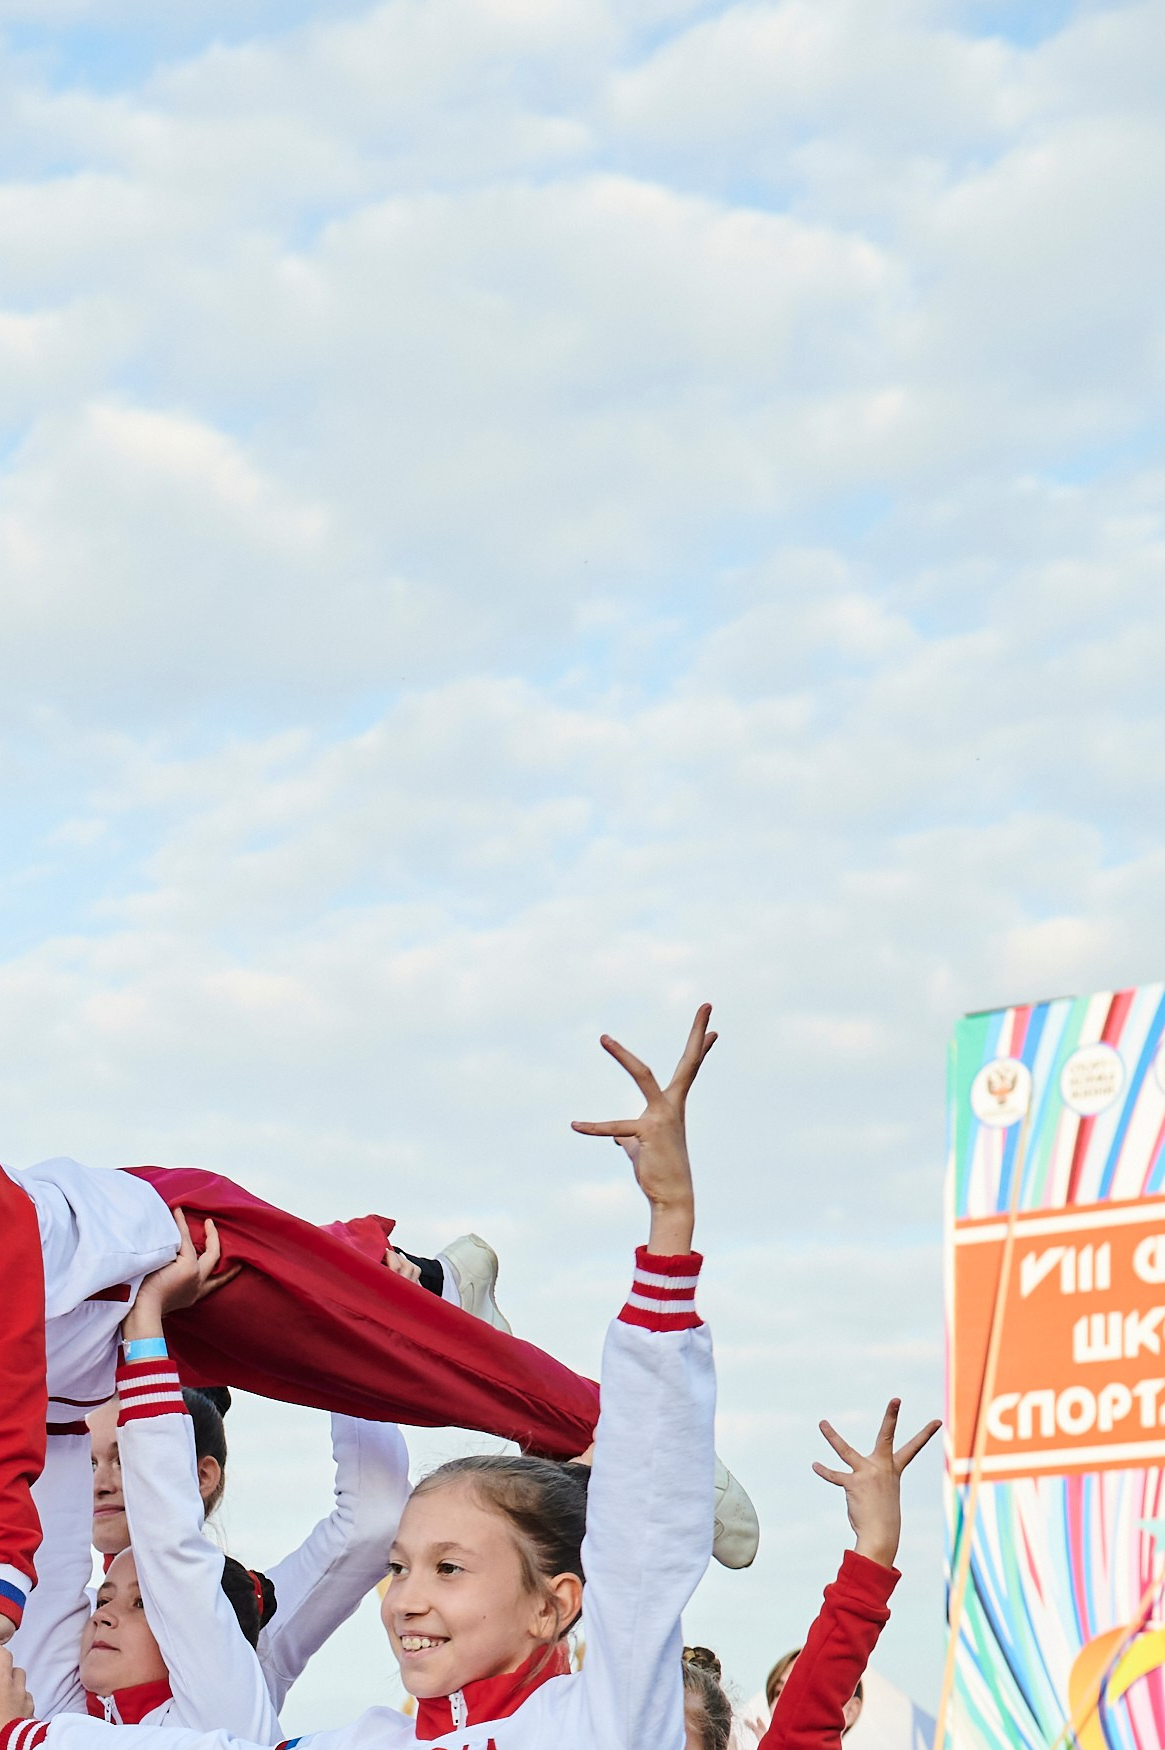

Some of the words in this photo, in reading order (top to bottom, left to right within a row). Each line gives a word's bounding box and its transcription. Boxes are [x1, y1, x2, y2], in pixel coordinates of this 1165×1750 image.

[1020, 1241, 1111, 1299] VIII
[1072, 1306, 1165, 1364] ШК
[987, 1377, 1165, 1442] СПОРТ
